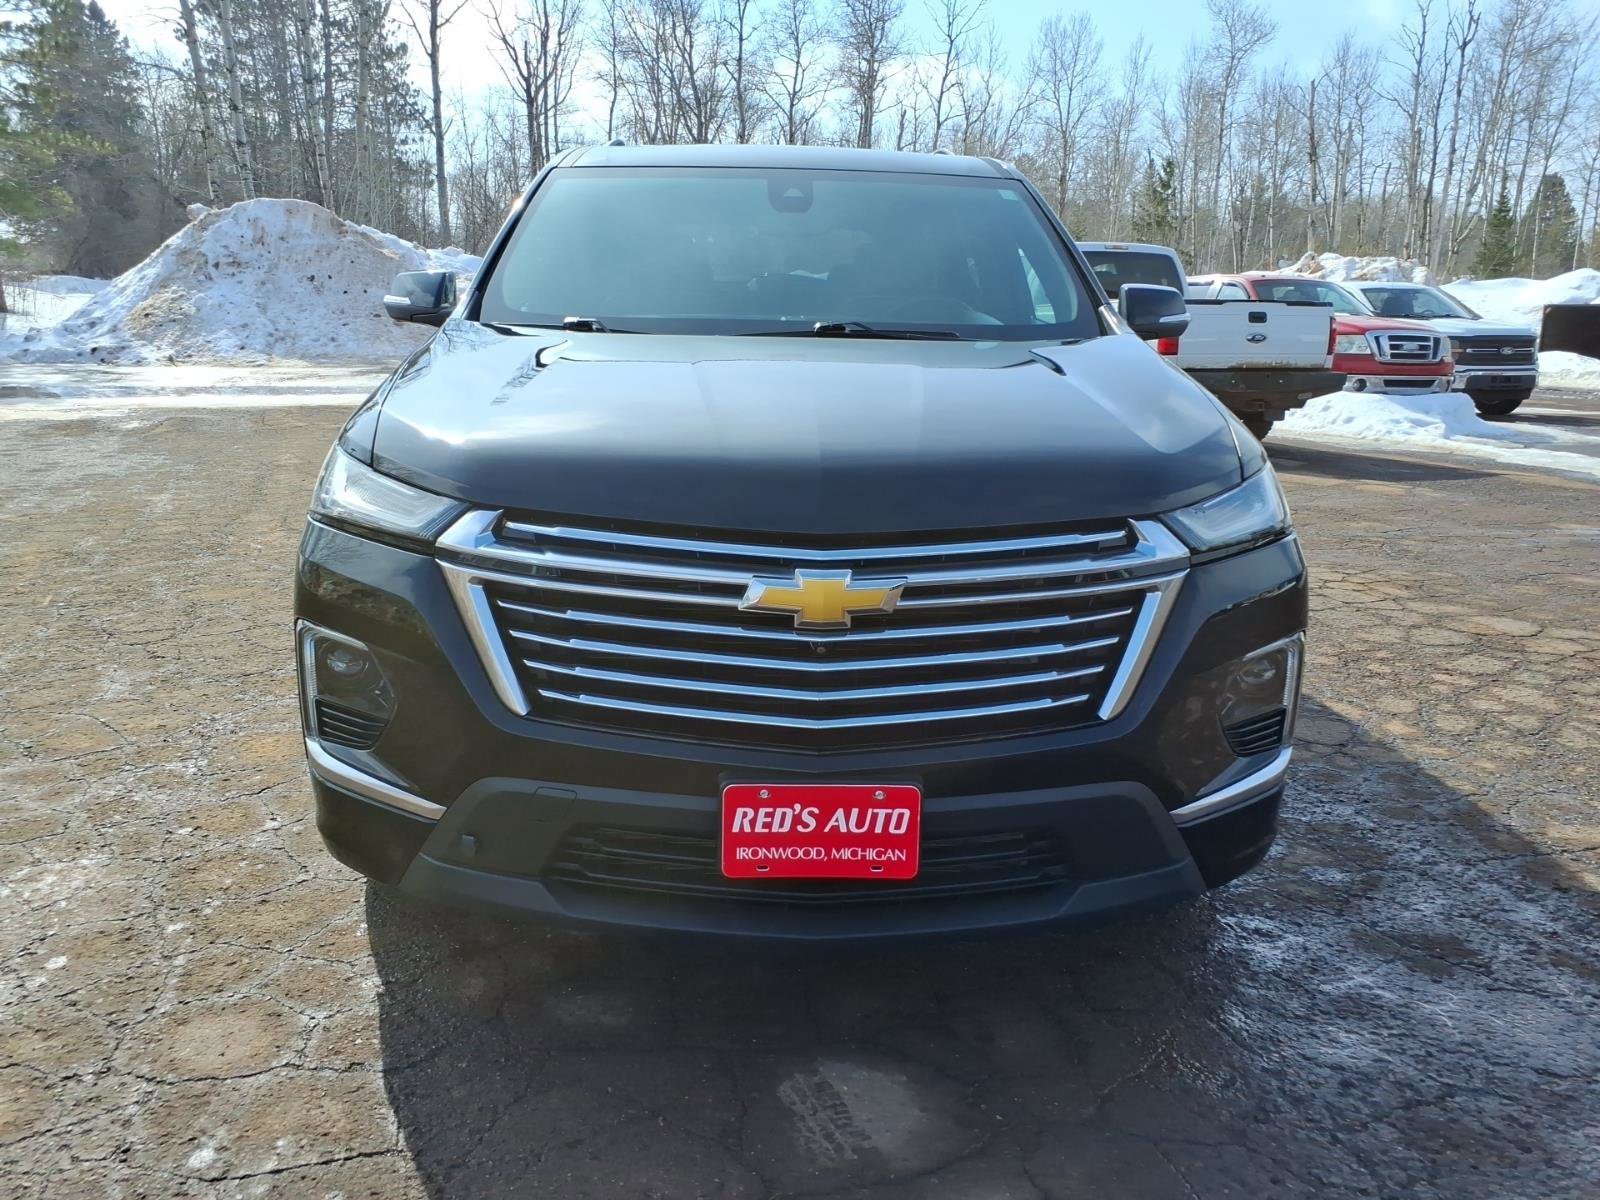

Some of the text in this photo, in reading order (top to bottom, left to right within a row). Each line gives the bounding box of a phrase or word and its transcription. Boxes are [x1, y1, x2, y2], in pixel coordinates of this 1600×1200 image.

[731, 803, 910, 834] RED'S AUTO
[736, 847, 906, 862] IRONWOOD, MICHIGAN
